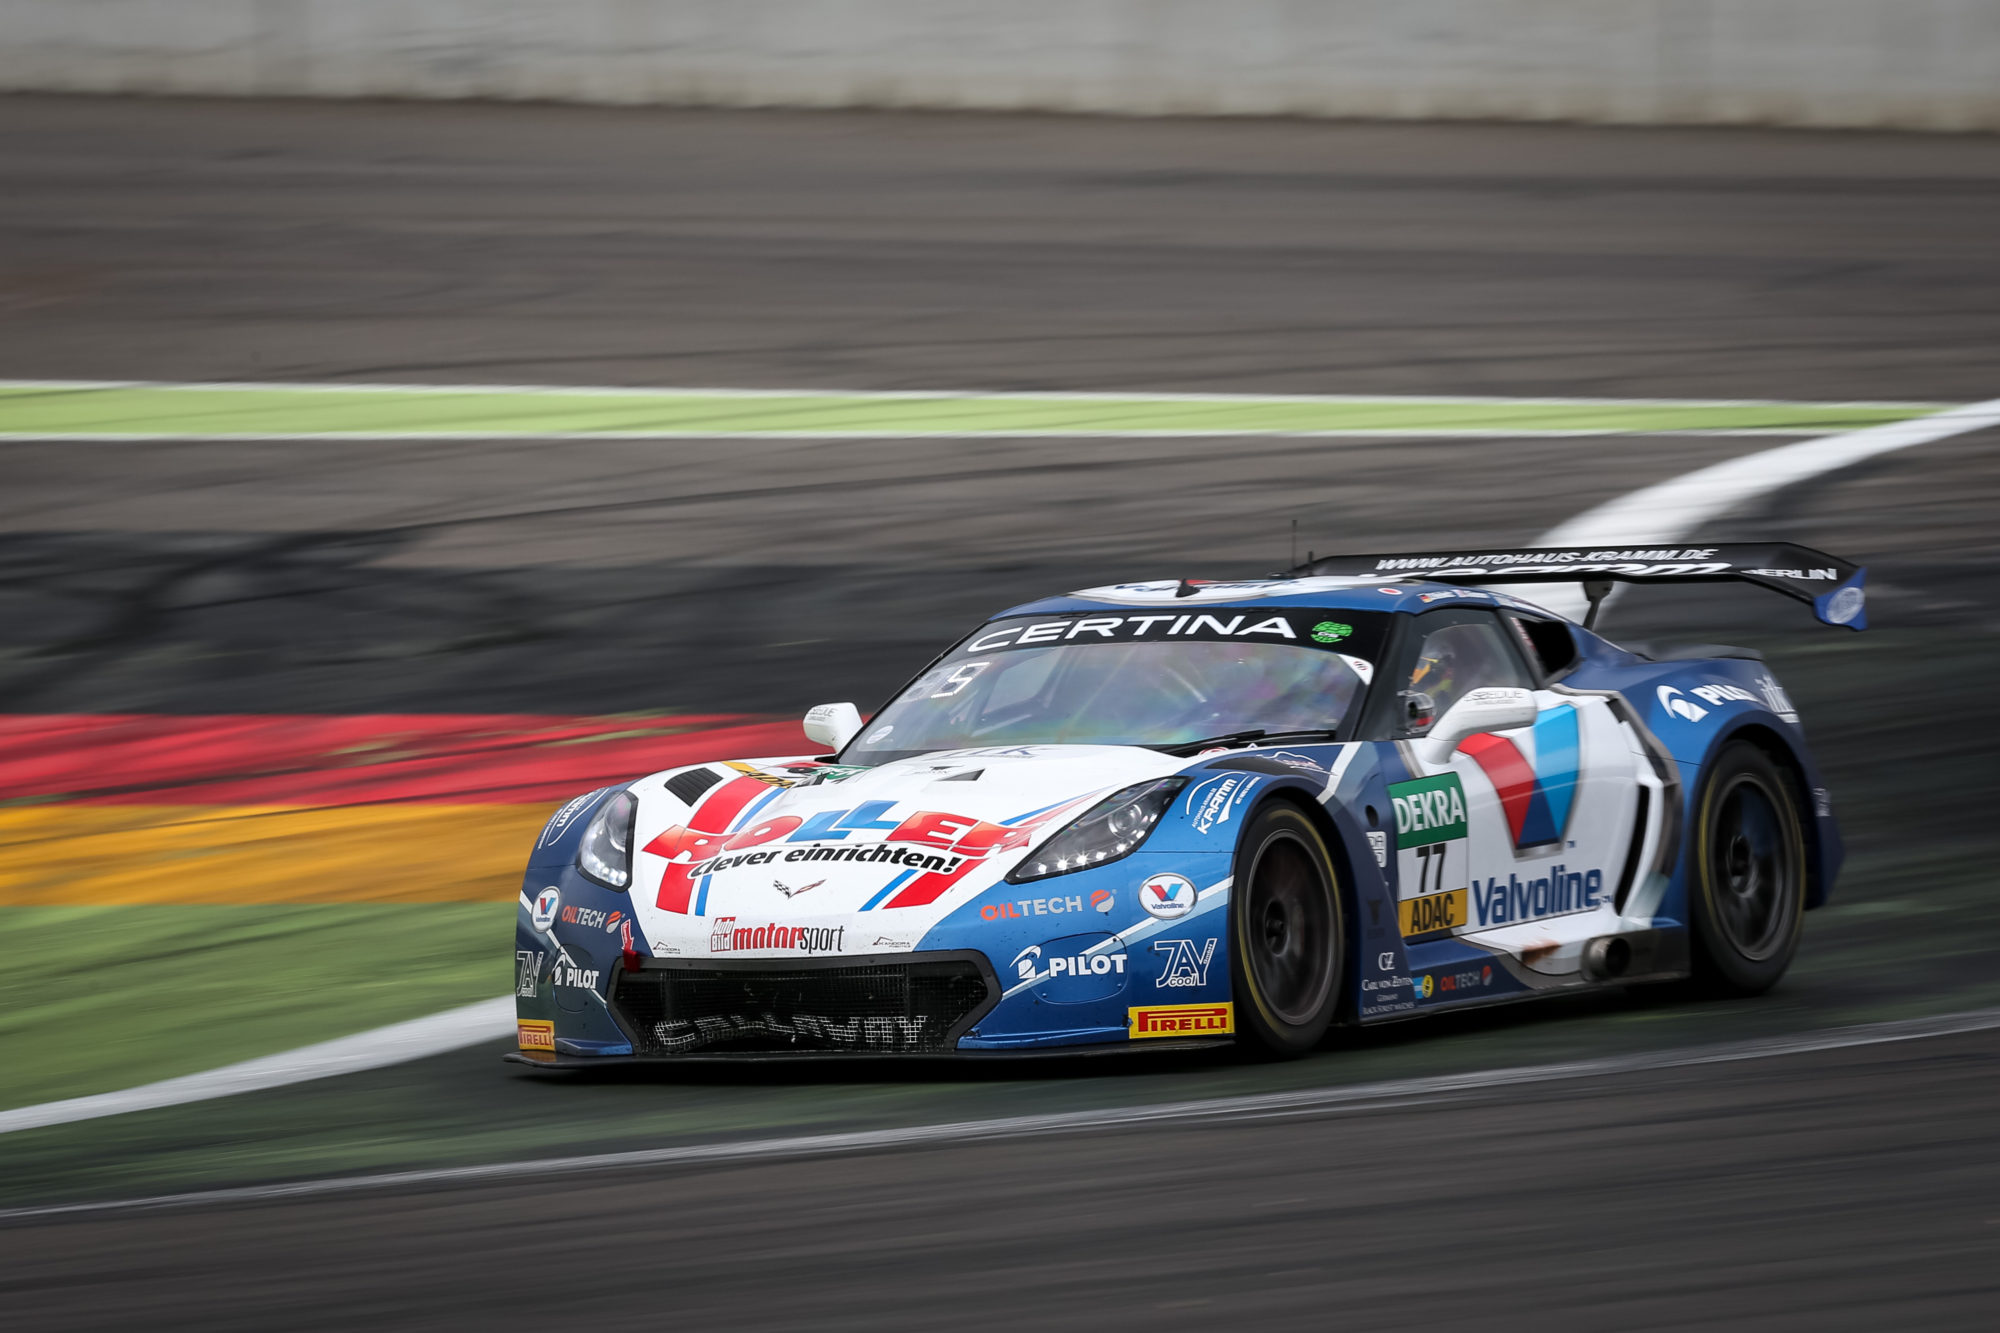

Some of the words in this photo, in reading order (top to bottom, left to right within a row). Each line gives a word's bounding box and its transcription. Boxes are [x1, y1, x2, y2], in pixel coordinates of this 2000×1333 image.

[967, 615, 1297, 653] CERTINA
[1393, 786, 1466, 835] DEKRA
[642, 800, 1035, 861] ROLLER
[690, 849, 781, 877] clever
[785, 842, 962, 873] einrichten!
[1416, 842, 1446, 893] 77
[980, 895, 1083, 921] OILTECH
[1471, 864, 1602, 926] Valvoline
[562, 905, 606, 929] OILTECH
[1411, 894, 1455, 934] ADAC
[566, 967, 600, 989] PILOT
[1049, 953, 1128, 977] PILOT
[1154, 938, 1218, 988] JAY
[520, 1025, 552, 1046] PIRELLI
[1138, 1008, 1227, 1032] PIRELLI
